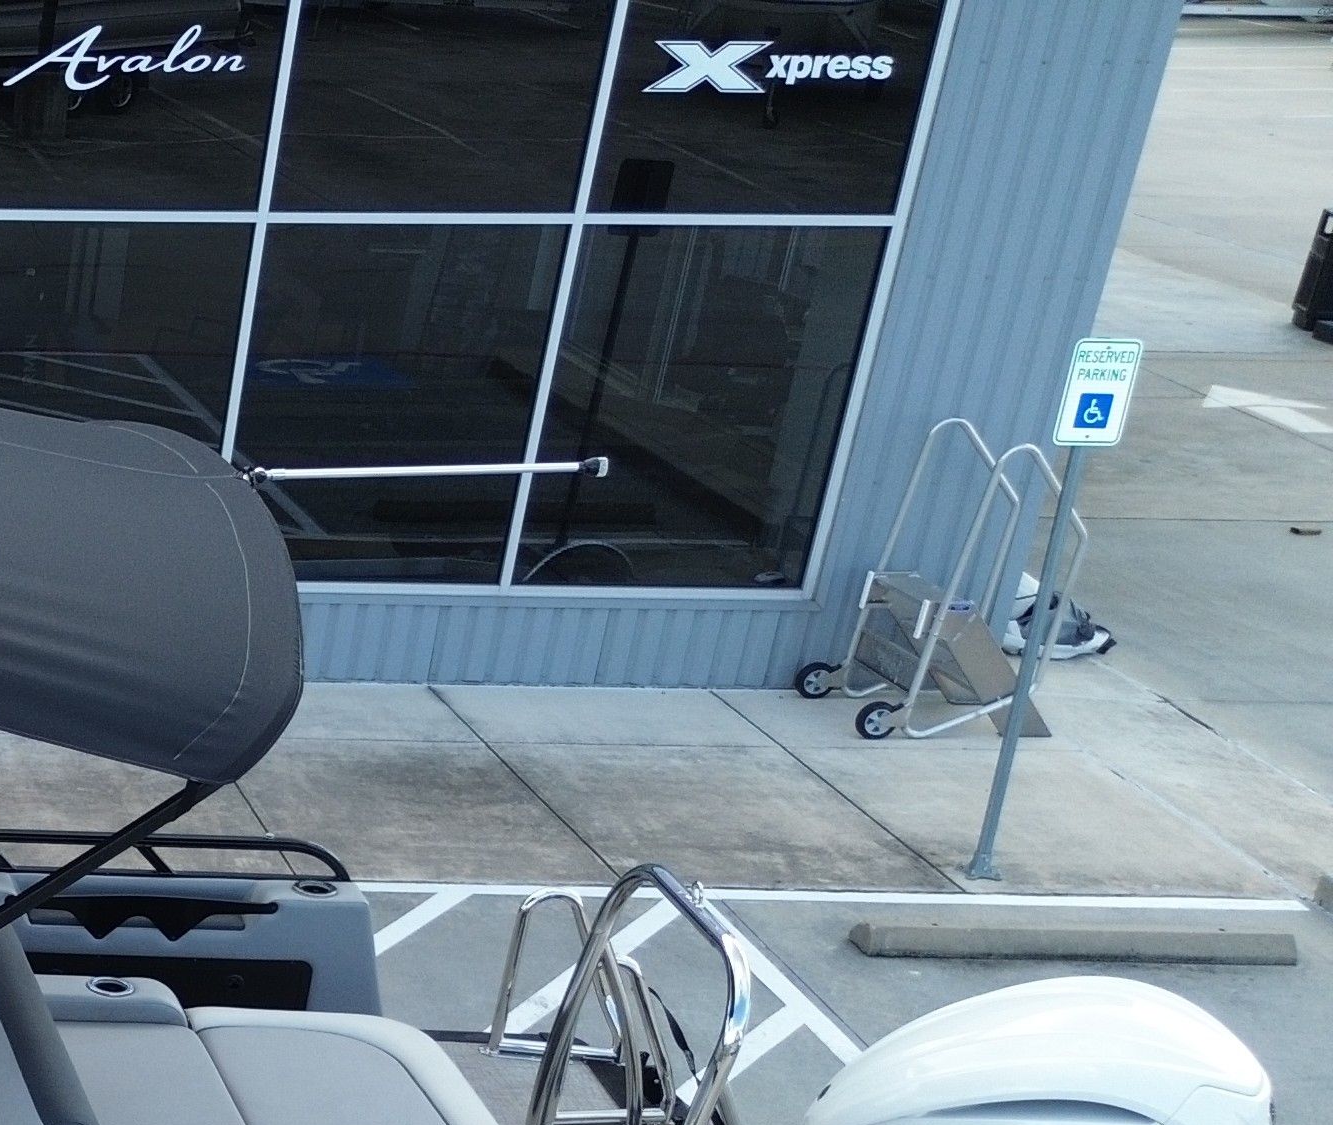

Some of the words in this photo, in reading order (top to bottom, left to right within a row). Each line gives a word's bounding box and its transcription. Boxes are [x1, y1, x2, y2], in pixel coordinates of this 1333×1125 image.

[3, 24, 245, 90] Avalon
[765, 54, 894, 85] xpress
[1077, 350, 1135, 364] RESERVED
[1077, 368, 1127, 382] PARKING
